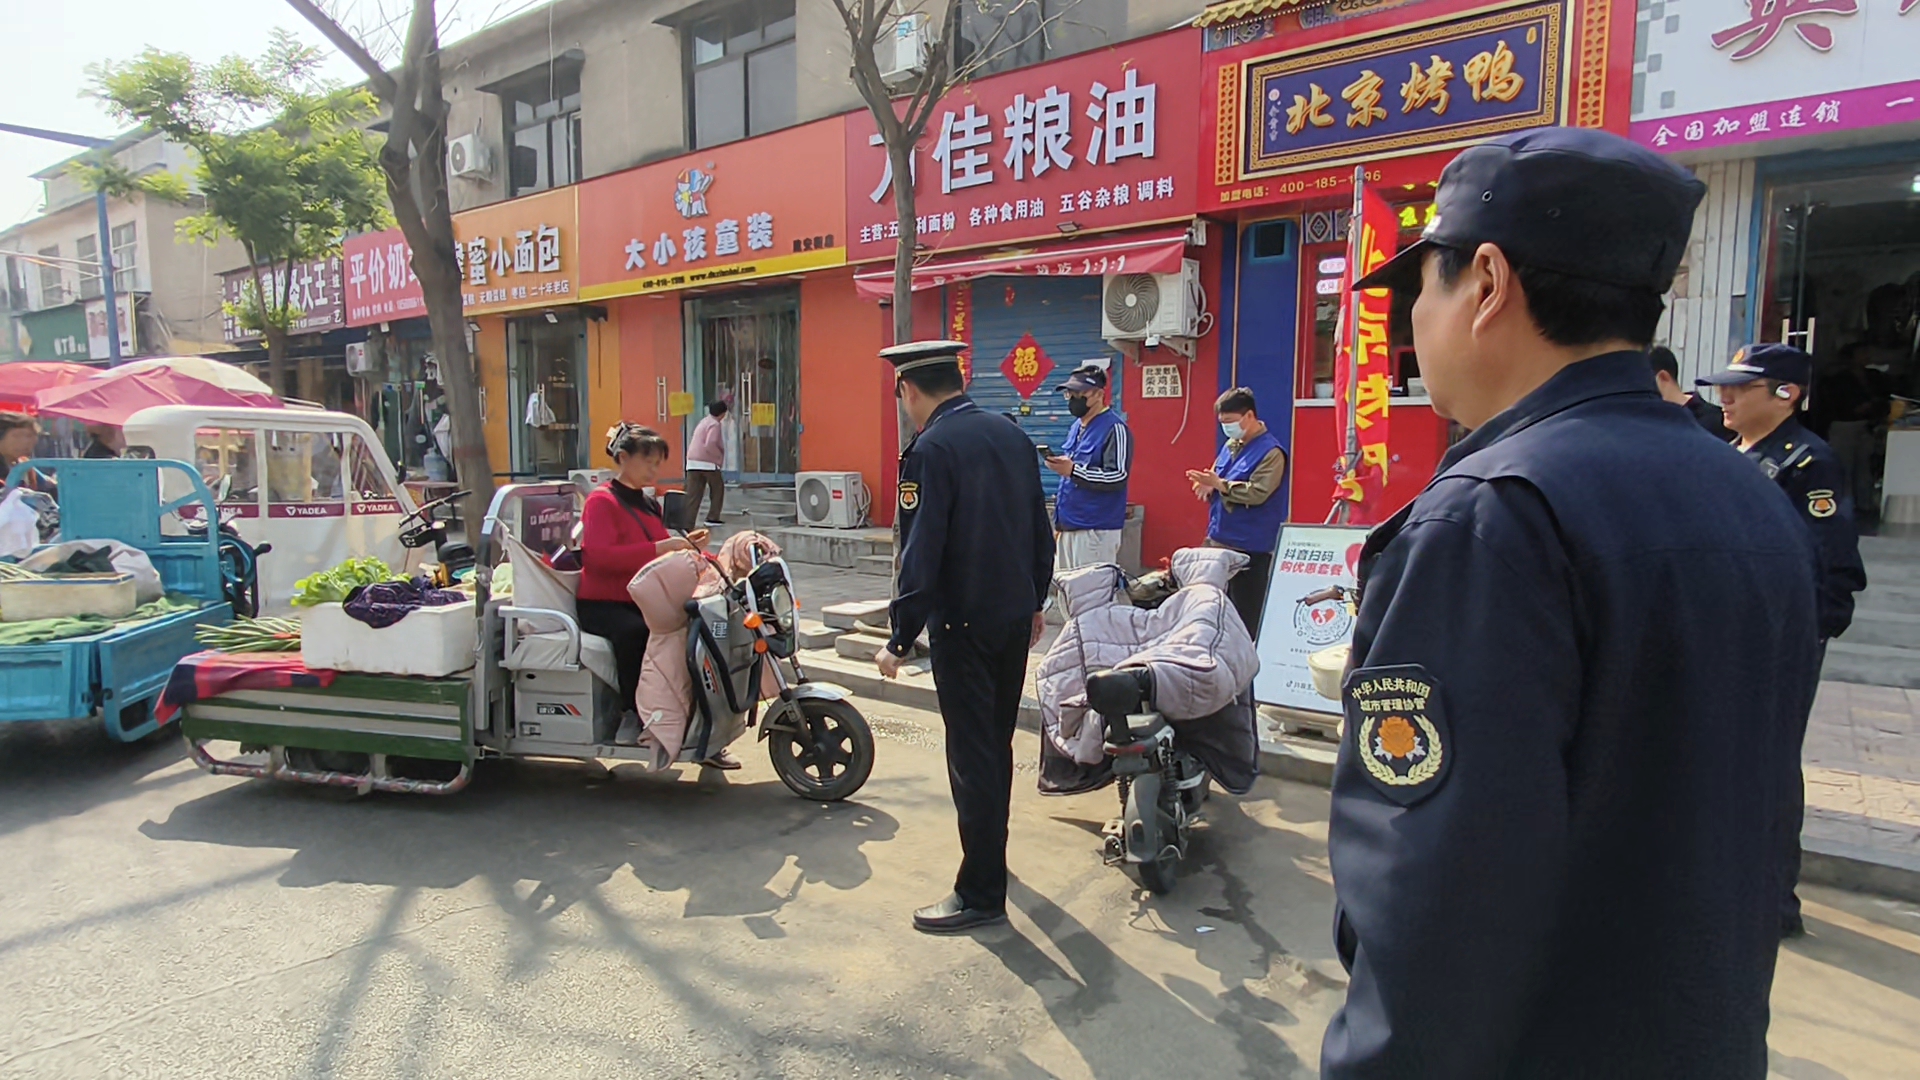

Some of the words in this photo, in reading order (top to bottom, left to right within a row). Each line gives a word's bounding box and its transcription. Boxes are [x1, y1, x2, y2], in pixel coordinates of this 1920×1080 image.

[1286, 40, 1525, 136] 北京烤鸭
[1651, 99, 1842, 147] 全国加盟连锁
[1280, 170, 1382, 194] 400-185-196
[969, 197, 1045, 228] 各种食用油
[1059, 185, 1131, 213] 五谷杂粮
[1138, 176, 1175, 203] 调料
[625, 212, 774, 271] 大小孩童装
[349, 243, 421, 300] 平价奶
[530, 280, 569, 296] 二十年老店
[1013, 346, 1039, 377] 福
[297, 507, 327, 515] YADEA
[366, 504, 395, 512] YADEA
[1284, 548, 1334, 562] 抖音扫码
[1279, 560, 1344, 577] 购优惠套餐
[1352, 678, 1431, 700] 中华人民共和国
